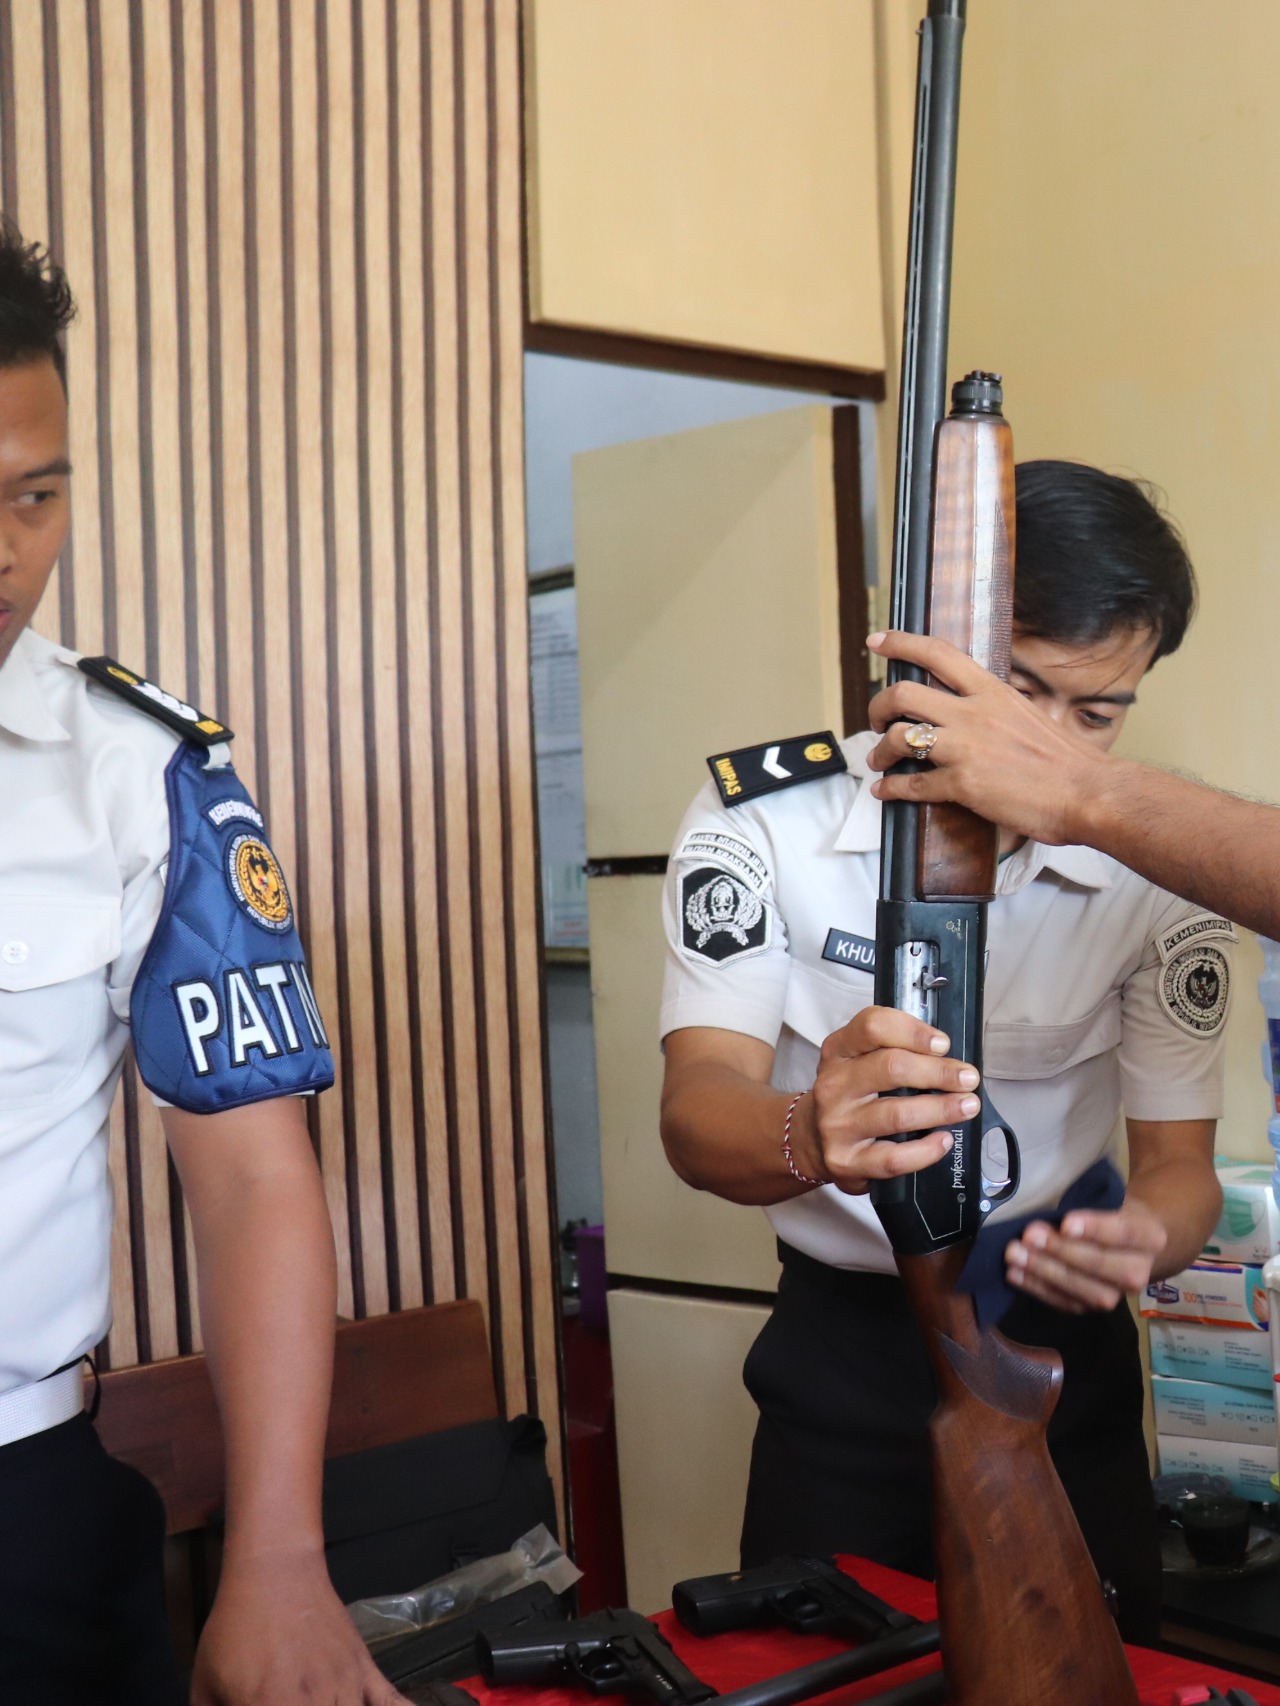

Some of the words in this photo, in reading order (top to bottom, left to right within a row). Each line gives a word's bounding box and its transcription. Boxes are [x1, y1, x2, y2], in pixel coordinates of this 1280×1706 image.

[715, 757, 742, 796] IMIPAS
[716, 848, 762, 887] KRAKSAAN
[835, 939, 875, 966] KHU
[1165, 921, 1231, 950] KEMENIMIPAS
[951, 1129, 966, 1188] professional
